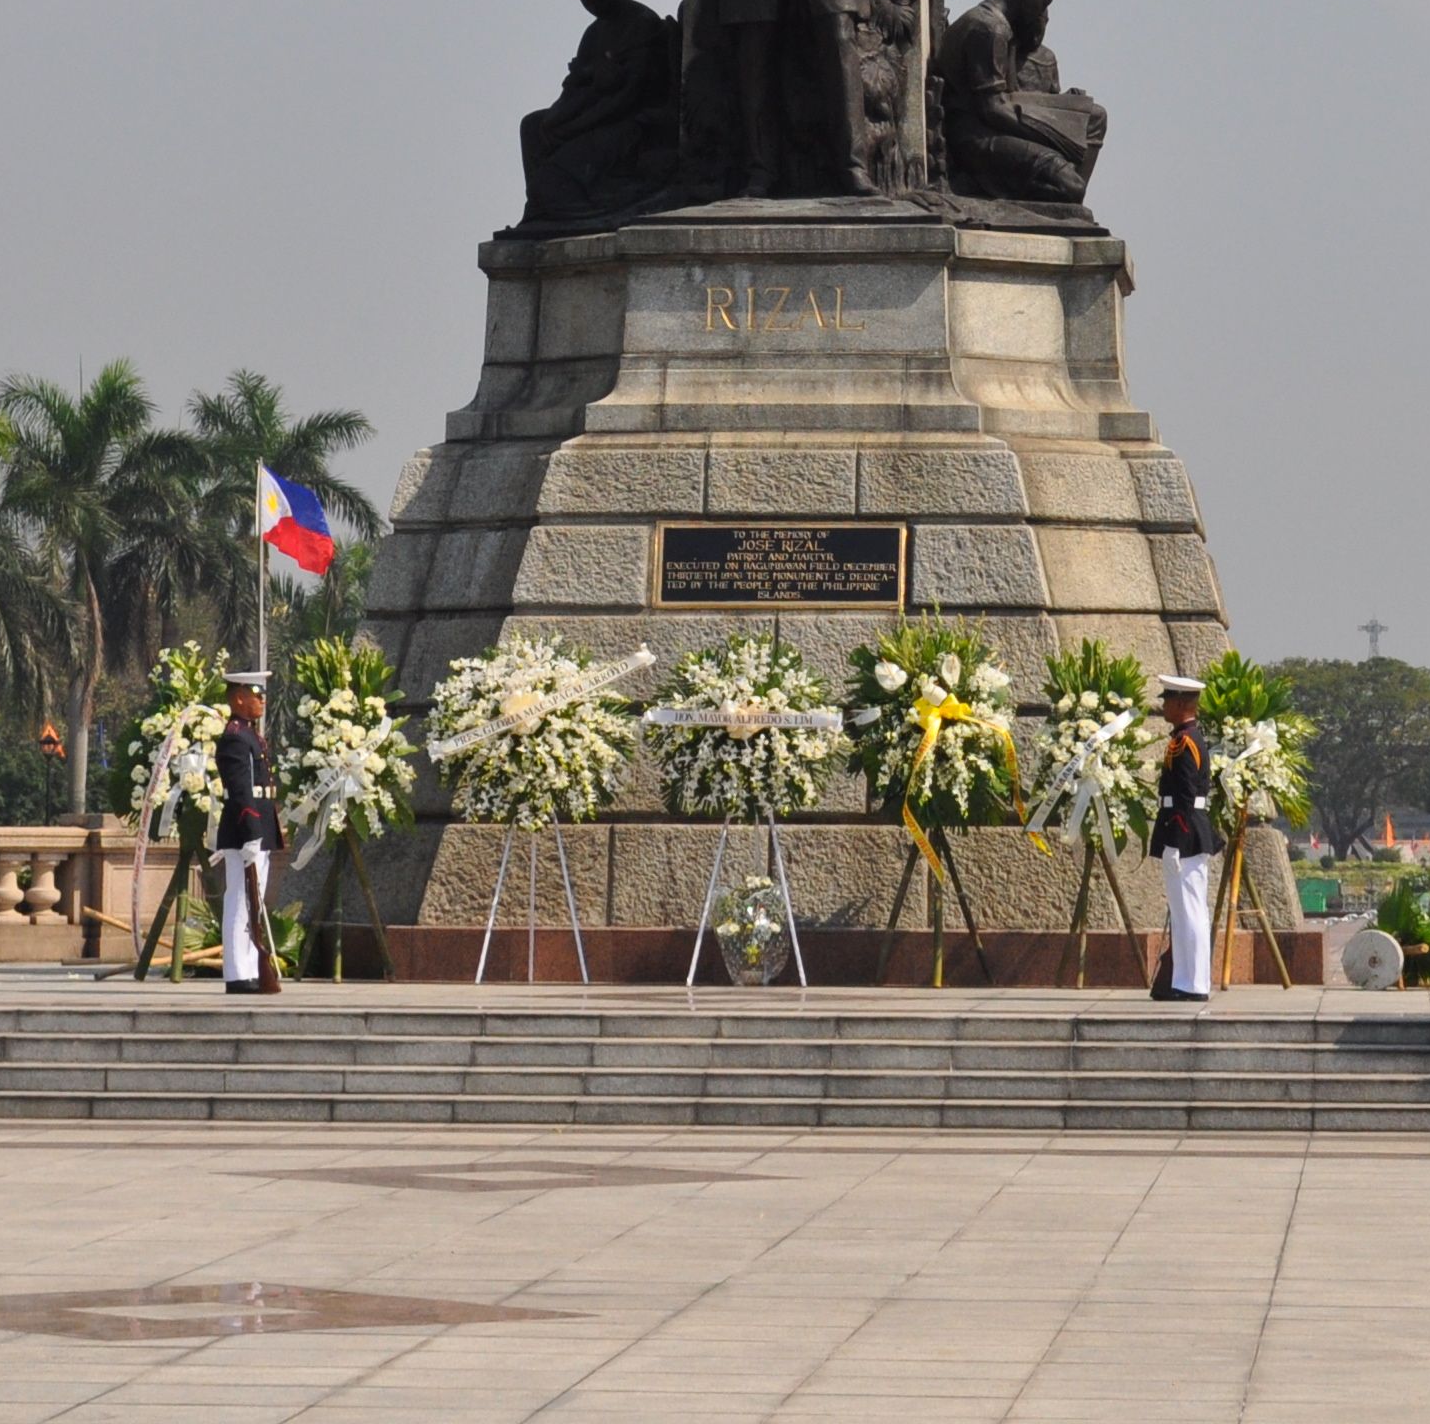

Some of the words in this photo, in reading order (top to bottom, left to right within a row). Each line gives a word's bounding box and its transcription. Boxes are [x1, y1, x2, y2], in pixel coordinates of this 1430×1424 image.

[705, 287, 865, 331] RIZAL
[733, 530, 745, 539] TO
[750, 530, 769, 539] THE
[774, 530, 813, 539] MEMORY
[817, 530, 830, 539] OF
[738, 540, 775, 552] JOSE
[782, 540, 825, 552] RIZAL
[727, 552, 765, 562] PATRIOT
[768, 552, 789, 561] AND
[792, 553, 835, 562] MARTYR
[666, 561, 721, 570] EXECUTED
[725, 561, 739, 570] ON
[743, 562, 807, 570] BAGUMBAYAN
[809, 562, 840, 571] FIELD
[843, 563, 897, 572] DECEMBER
[667, 571, 717, 580] THIRTIETH
[747, 572, 770, 580] THIS
[773, 572, 831, 581] MONUMENT
[834, 573, 845, 581] IS
[666, 581, 686, 589] TED
[690, 581, 702, 589] BY
[709, 581, 729, 590] THE
[733, 582, 772, 590] PEOPLE
[777, 582, 791, 590] OF
[797, 582, 818, 590] THE
[823, 582, 881, 591] PHILIPPINE
[483, 713, 523, 737] GLORIA
[523, 686, 584, 717] MACAPAGAL
[675, 712, 696, 723] HON.
[698, 712, 732, 724] MAYOR
[735, 713, 782, 725] ALFREDO
[794, 714, 813, 725] LIM
